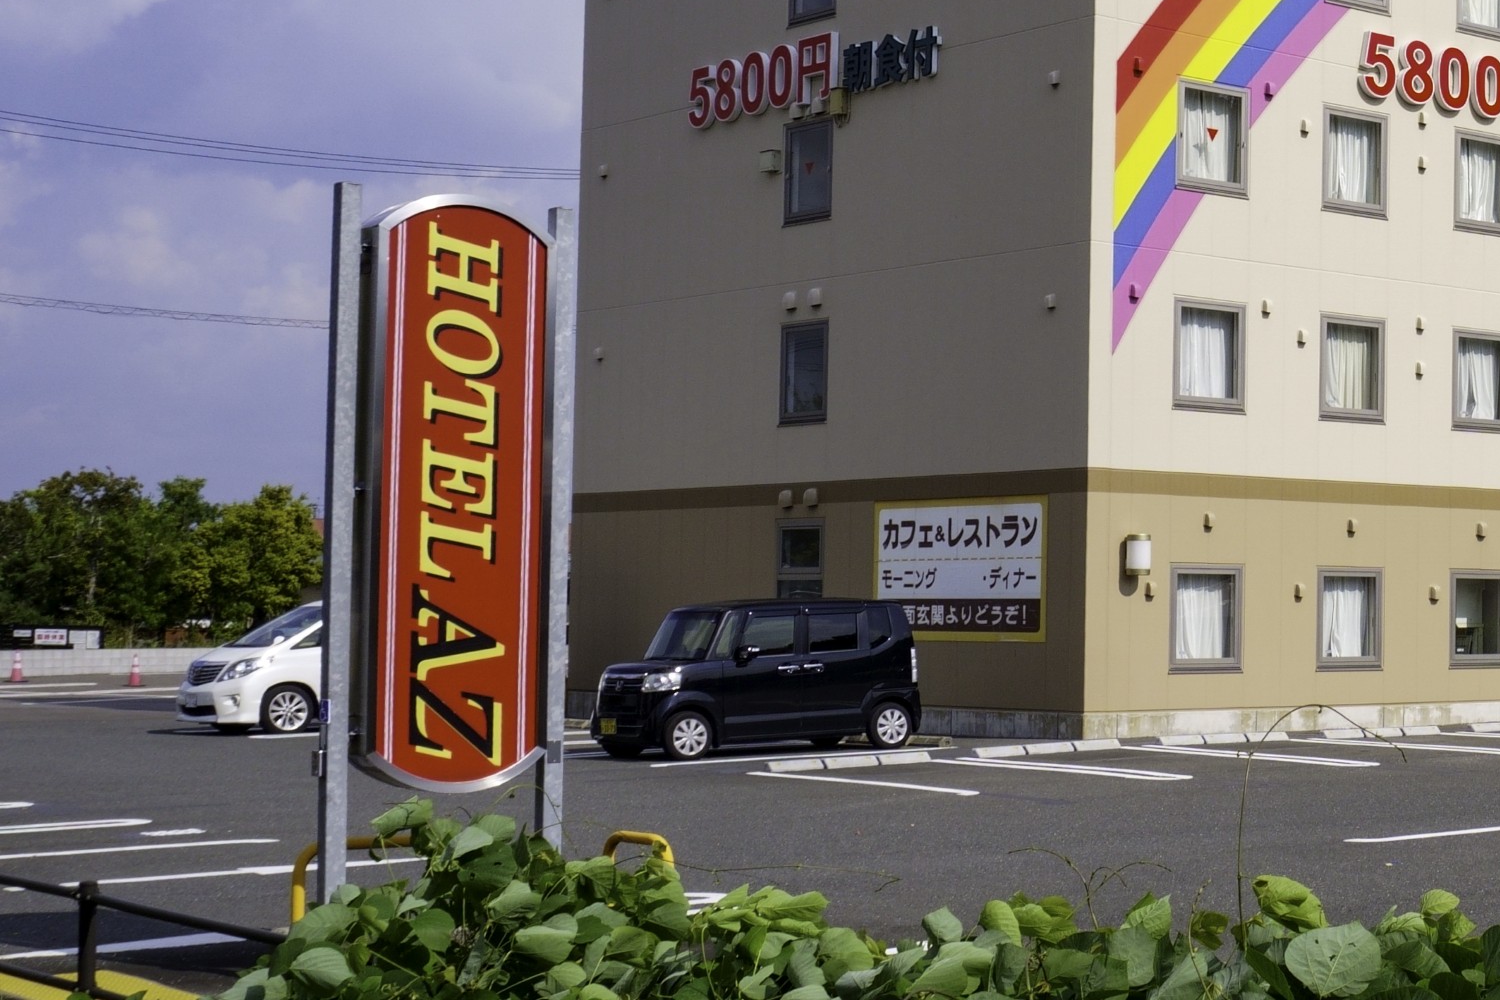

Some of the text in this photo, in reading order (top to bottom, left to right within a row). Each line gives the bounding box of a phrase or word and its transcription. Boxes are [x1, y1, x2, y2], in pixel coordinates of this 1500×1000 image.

[688, 26, 941, 128] 5800円 朝食付
[409, 221, 505, 767] HOTEL AZ
[883, 516, 1038, 549] カフェ&レストラン
[882, 568, 937, 589] モーニング
